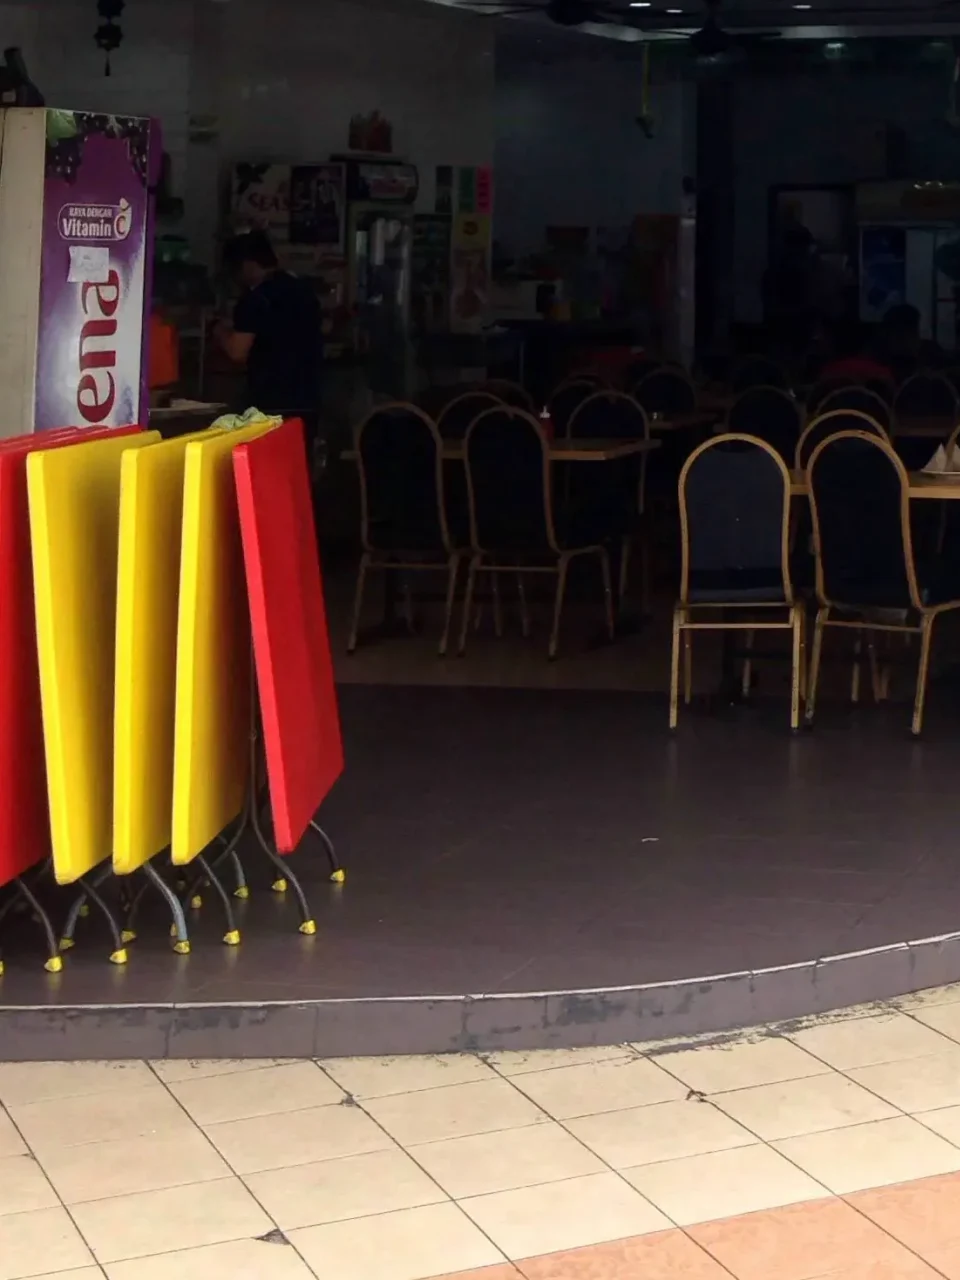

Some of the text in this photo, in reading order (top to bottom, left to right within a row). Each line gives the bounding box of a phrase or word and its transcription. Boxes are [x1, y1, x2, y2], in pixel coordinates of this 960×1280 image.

[87, 207, 113, 218] DENGAN
[62, 218, 112, 238] Vitamin
[77, 269, 120, 428] ena
